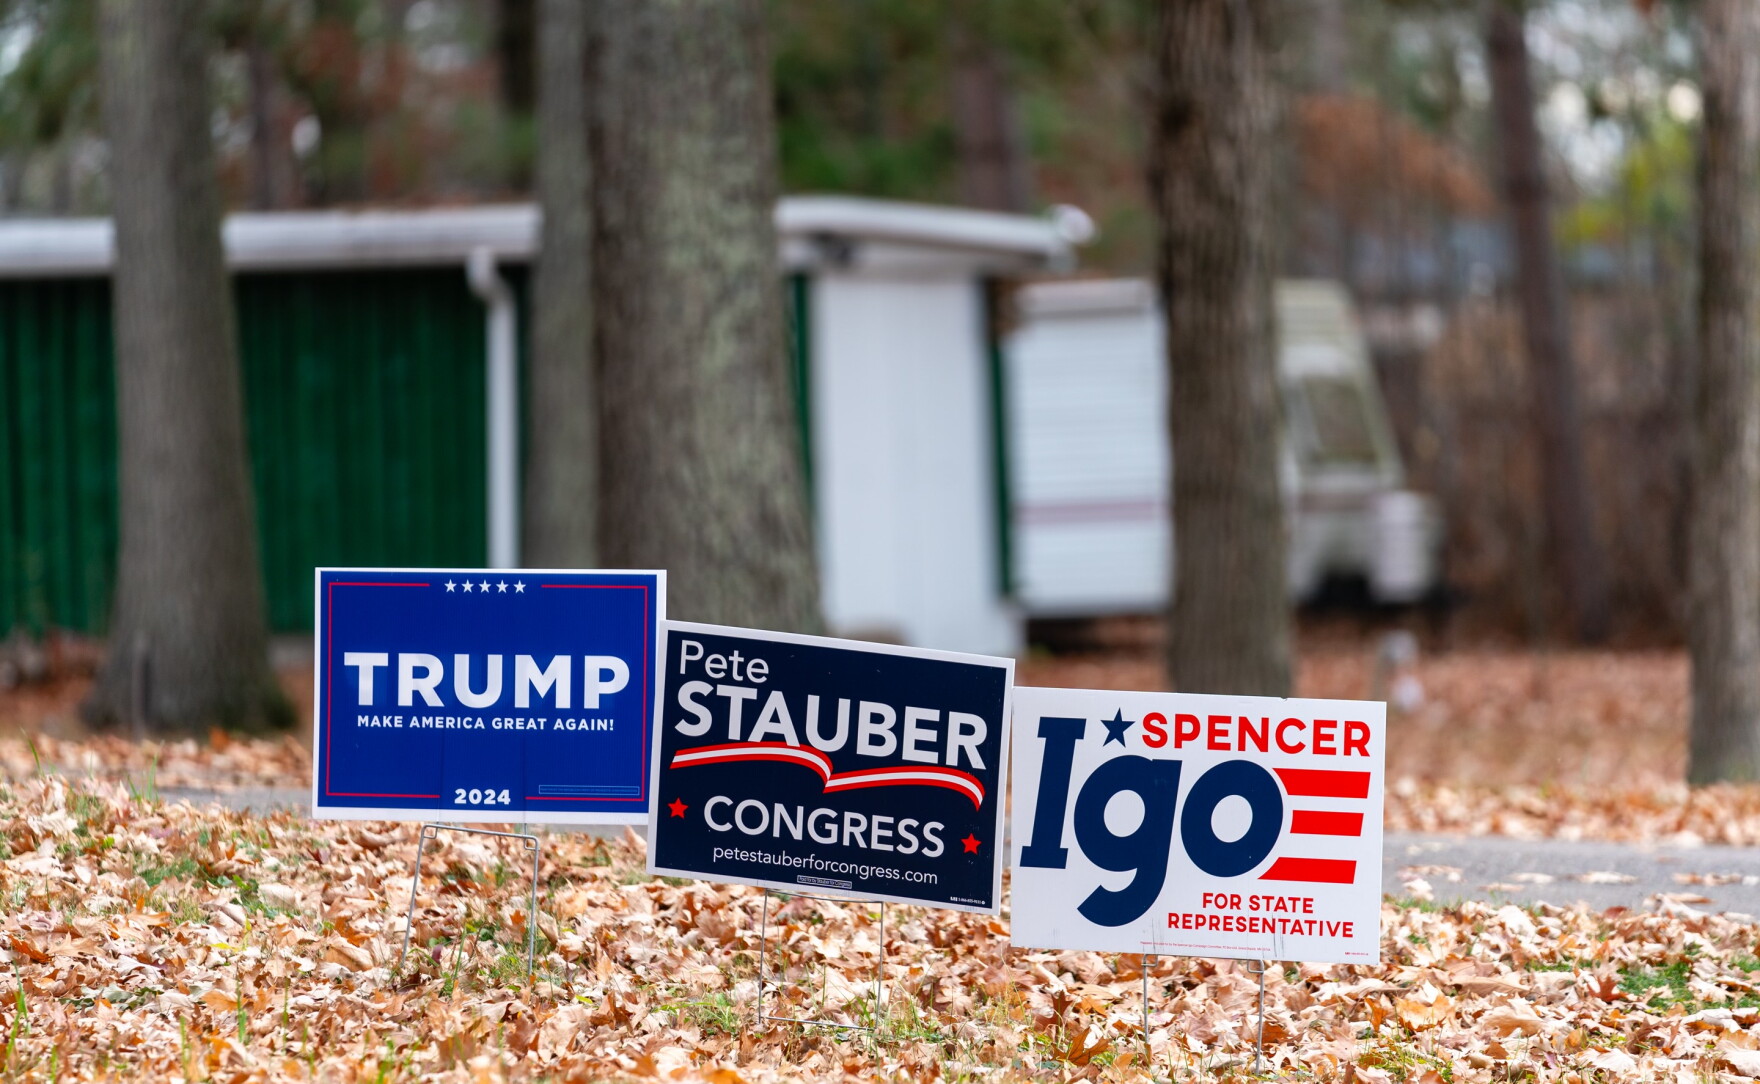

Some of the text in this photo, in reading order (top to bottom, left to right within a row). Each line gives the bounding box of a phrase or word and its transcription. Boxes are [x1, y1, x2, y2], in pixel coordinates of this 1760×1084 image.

[344, 652, 630, 709] TRUMP
[679, 639, 769, 683] Pete
[357, 715, 614, 731] MAKE AMERICA GREAT AGAIN!
[674, 680, 988, 770] STAUBER
[1142, 712, 1371, 757] SPENCER
[454, 788, 511, 805] 2024
[703, 795, 945, 858] CONGRESS
[1019, 716, 1284, 927] Igo
[712, 845, 938, 885] petestauberforcongress.com
[1167, 912, 1354, 938] REPRESENTATIVE
[1202, 892, 1314, 914] FOR STATE
